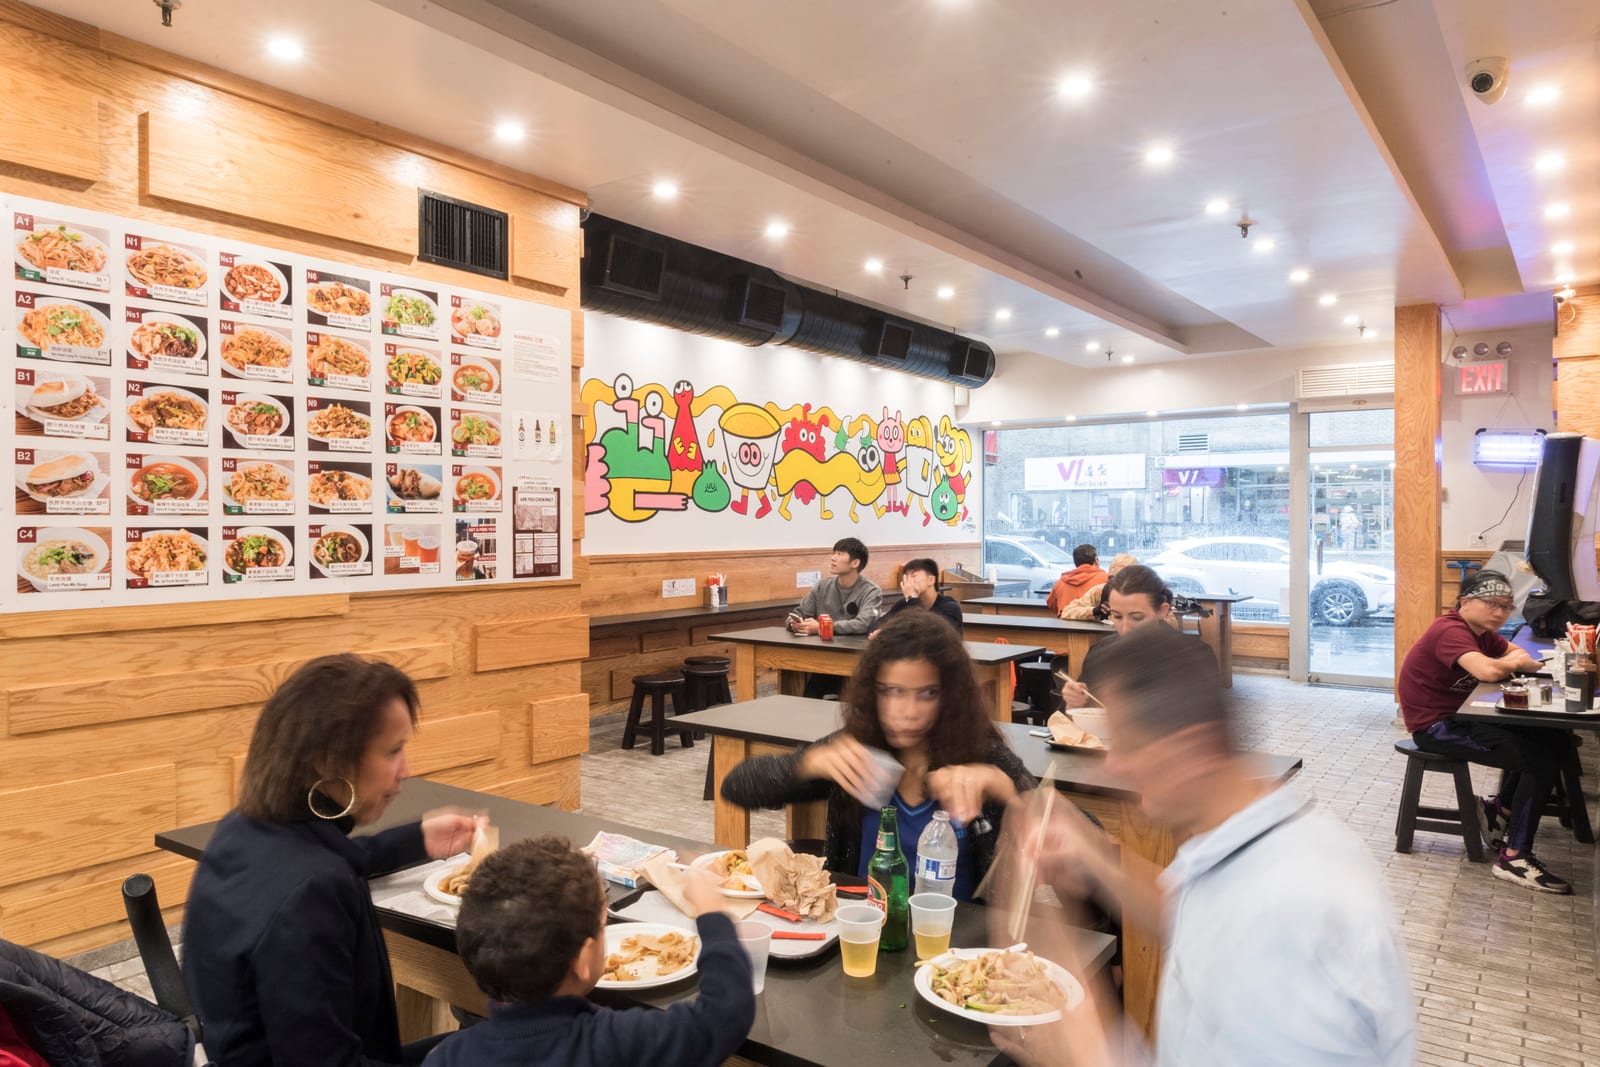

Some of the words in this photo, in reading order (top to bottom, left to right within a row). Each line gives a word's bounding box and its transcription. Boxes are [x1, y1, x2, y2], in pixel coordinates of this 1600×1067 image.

[16, 216, 29, 226] A1
[127, 237, 138, 246] N1
[382, 285, 390, 293] L1
[18, 295, 31, 304] A2
[18, 372, 29, 380] B1
[1461, 364, 1505, 392] EXIT
[129, 384, 139, 392] N2
[17, 452, 30, 460] B2
[1178, 470, 1200, 484] V1
[19, 530, 33, 539] C4
[128, 530, 139, 538] N3
